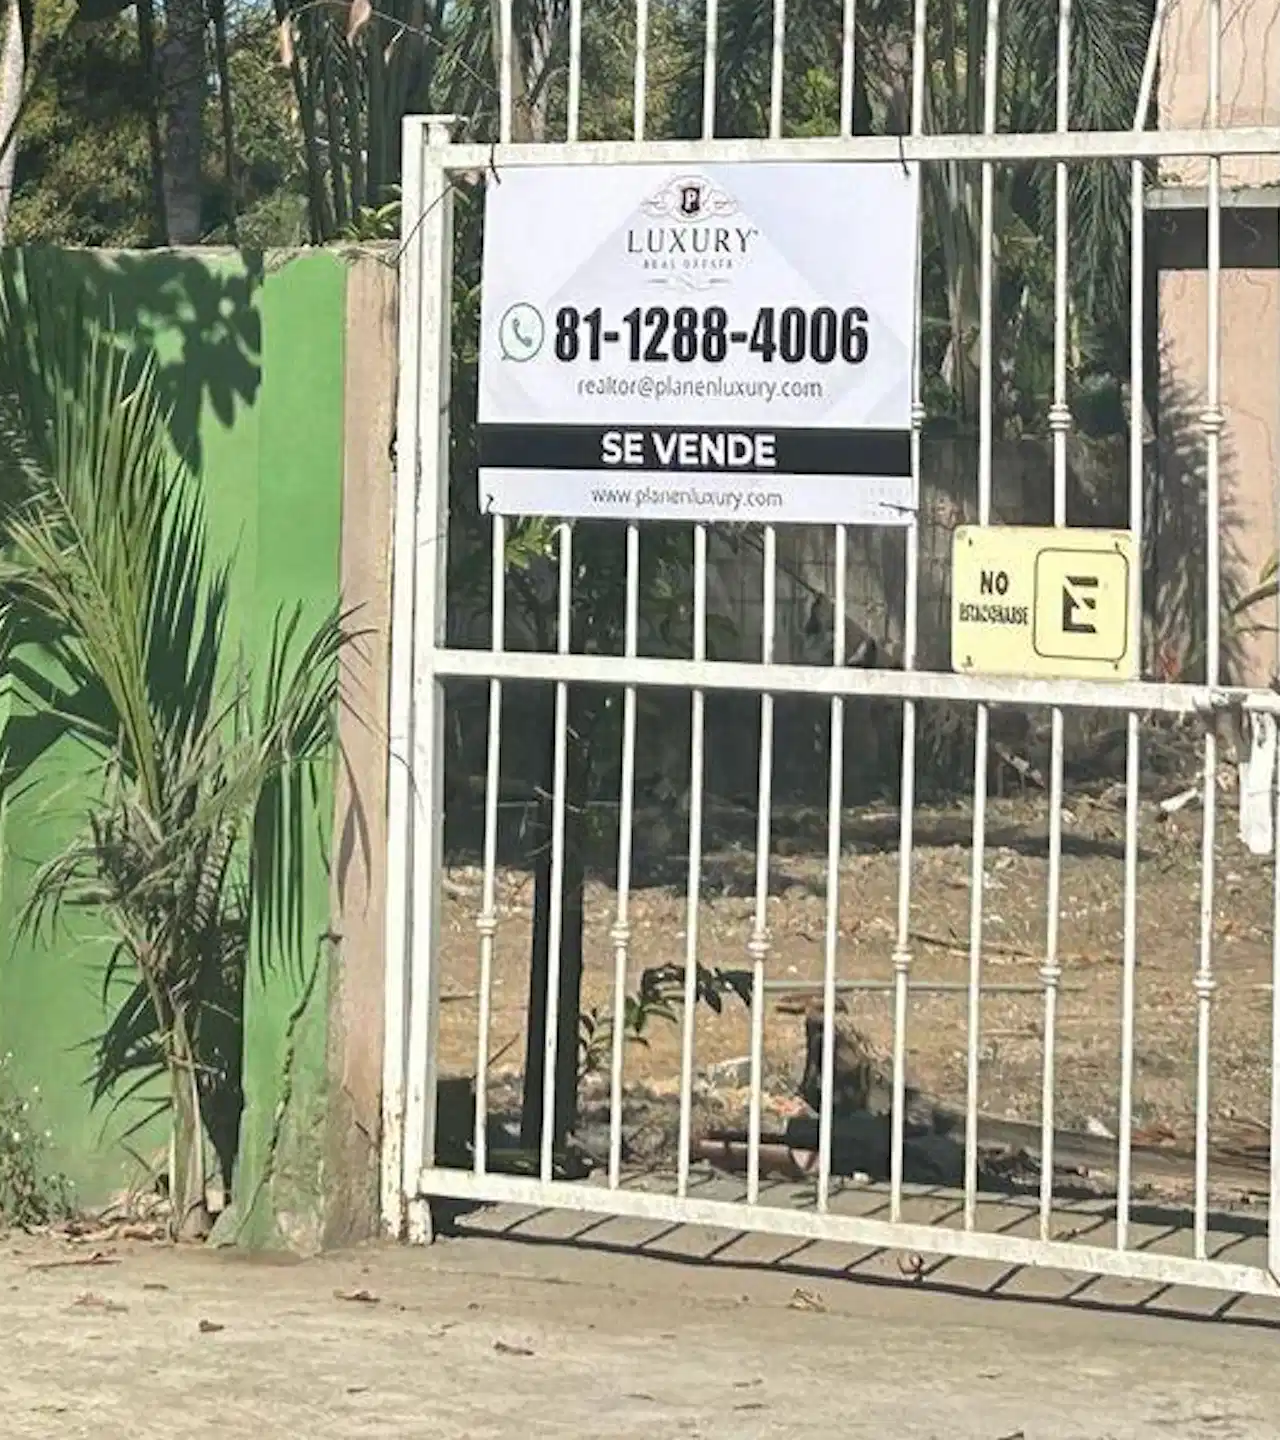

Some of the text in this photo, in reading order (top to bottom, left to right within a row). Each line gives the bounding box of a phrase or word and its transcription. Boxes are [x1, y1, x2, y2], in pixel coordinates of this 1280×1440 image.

[627, 227, 753, 254] LUXURY
[554, 306, 869, 364] 81-1288-4006
[578, 375, 823, 403] realtor@planenluxury.com
[602, 431, 776, 467] SE VENDE
[591, 486, 783, 510] www.planenluxury.com
[980, 570, 1009, 595] NO
